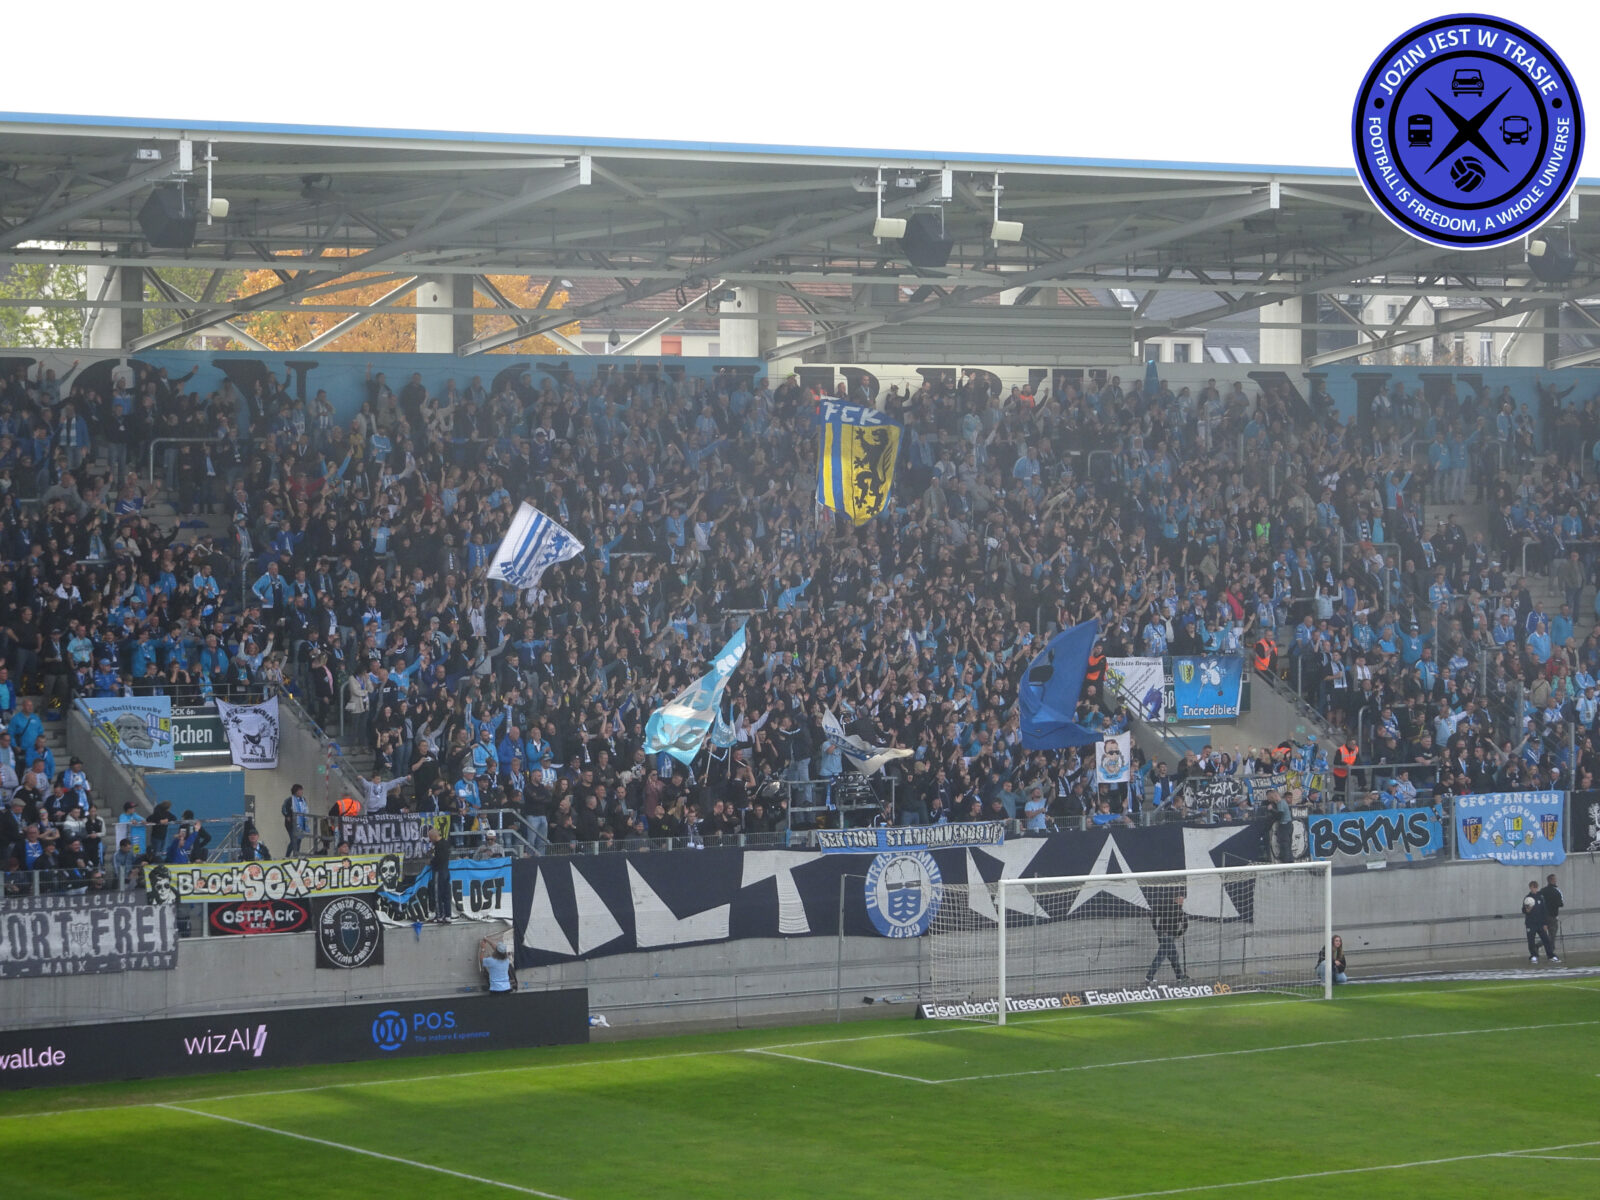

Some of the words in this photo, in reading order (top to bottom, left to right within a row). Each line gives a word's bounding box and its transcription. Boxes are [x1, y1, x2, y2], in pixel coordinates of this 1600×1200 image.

[823, 401, 882, 425] FCK
[1183, 704, 1237, 716] Incredibles
[171, 724, 213, 744] ßchen
[343, 822, 420, 844] FANCLUB
[1310, 811, 1431, 858] BSKMS
[469, 877, 505, 912] OST
[222, 909, 295, 923] OSTPACK
[91, 906, 169, 955] FREI
[887, 922, 921, 938] 1999
[1084, 986, 1159, 1006] Eisenbach
[921, 996, 999, 1019] Eisenbach
